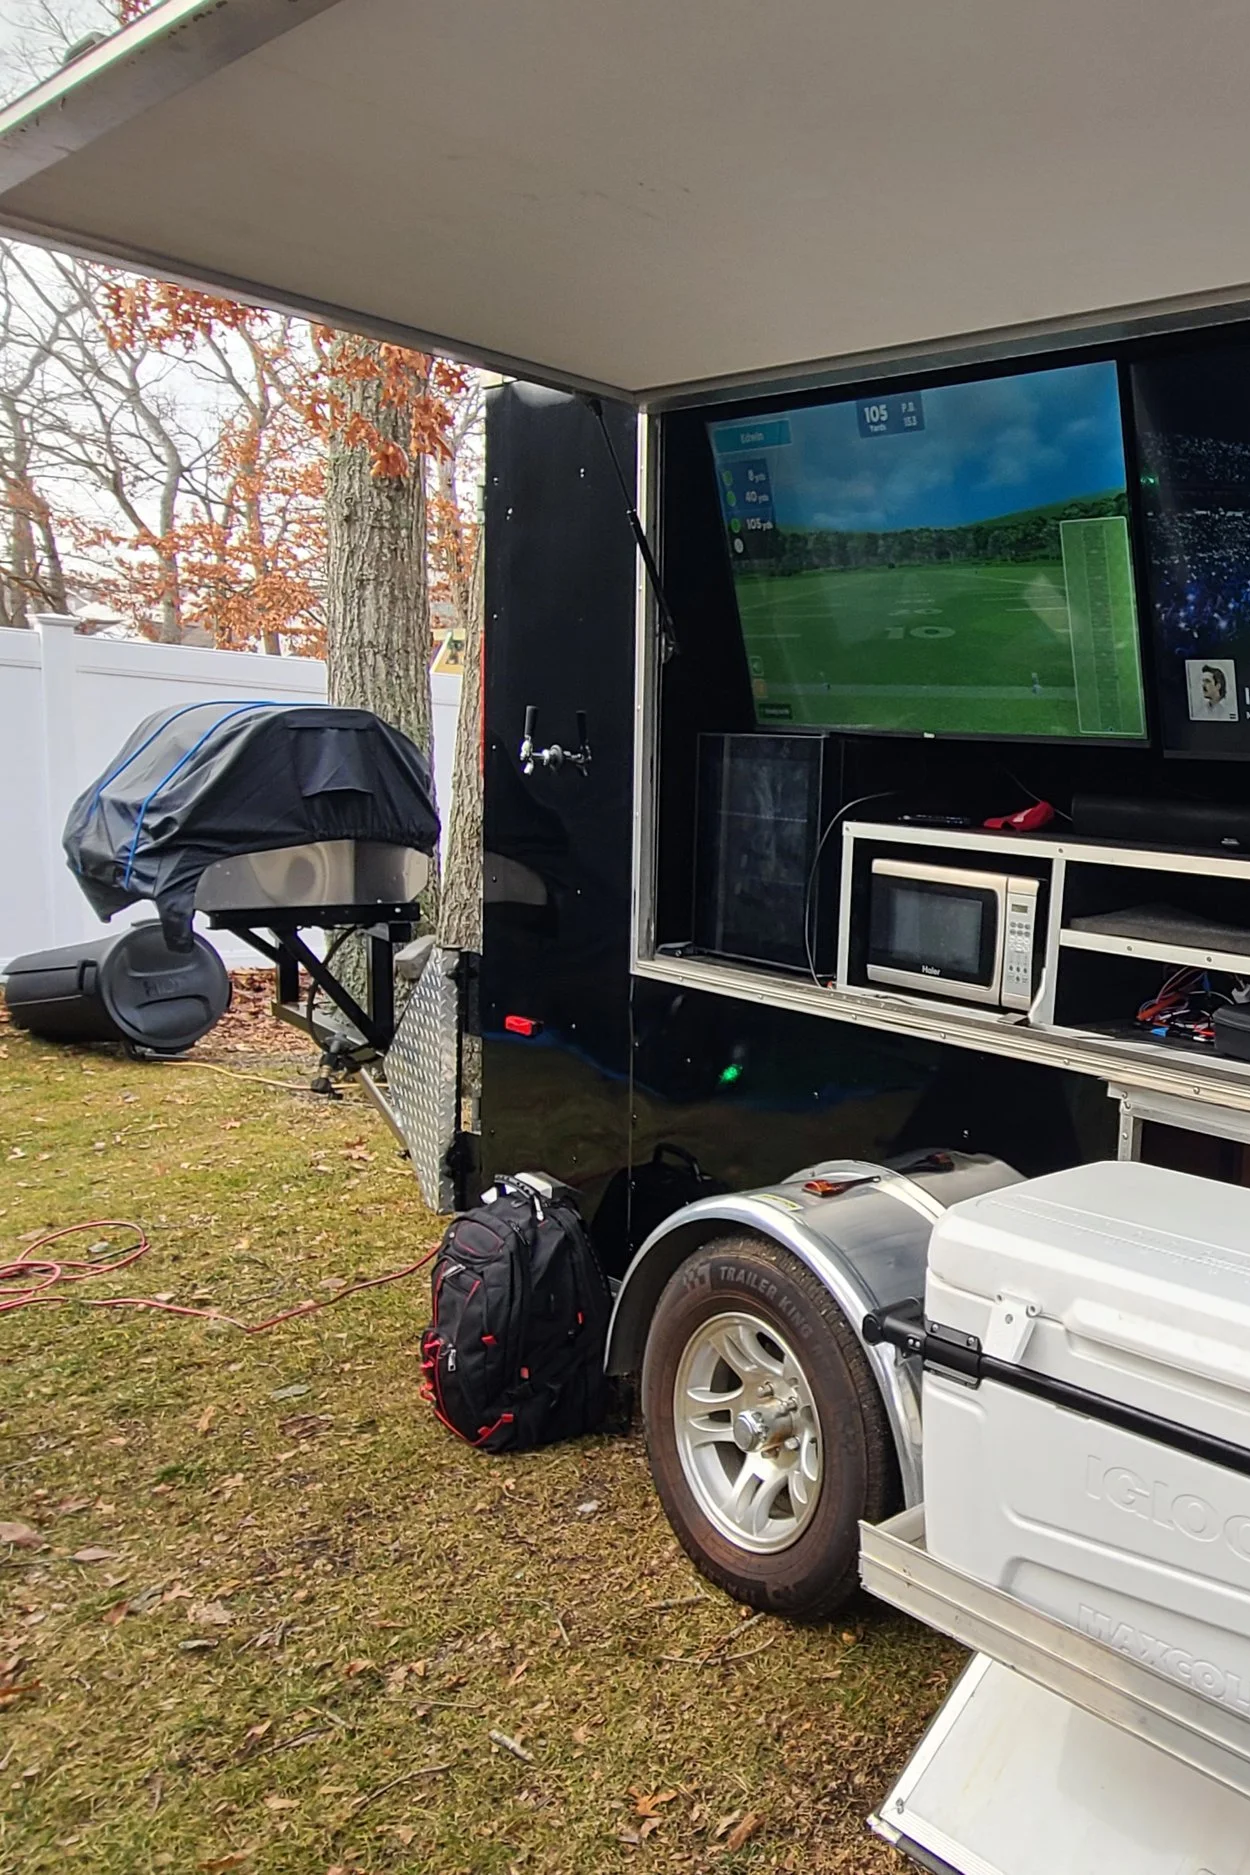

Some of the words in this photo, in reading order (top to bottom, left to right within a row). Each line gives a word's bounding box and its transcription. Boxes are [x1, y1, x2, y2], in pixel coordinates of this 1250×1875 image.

[864, 404, 888, 423] 105
[746, 518, 761, 530] 105
[1245, 687, 1250, 705] I
[921, 965, 940, 976] Haier
[719, 1265, 778, 1299] TRAILER
[778, 1296, 814, 1338] KING
